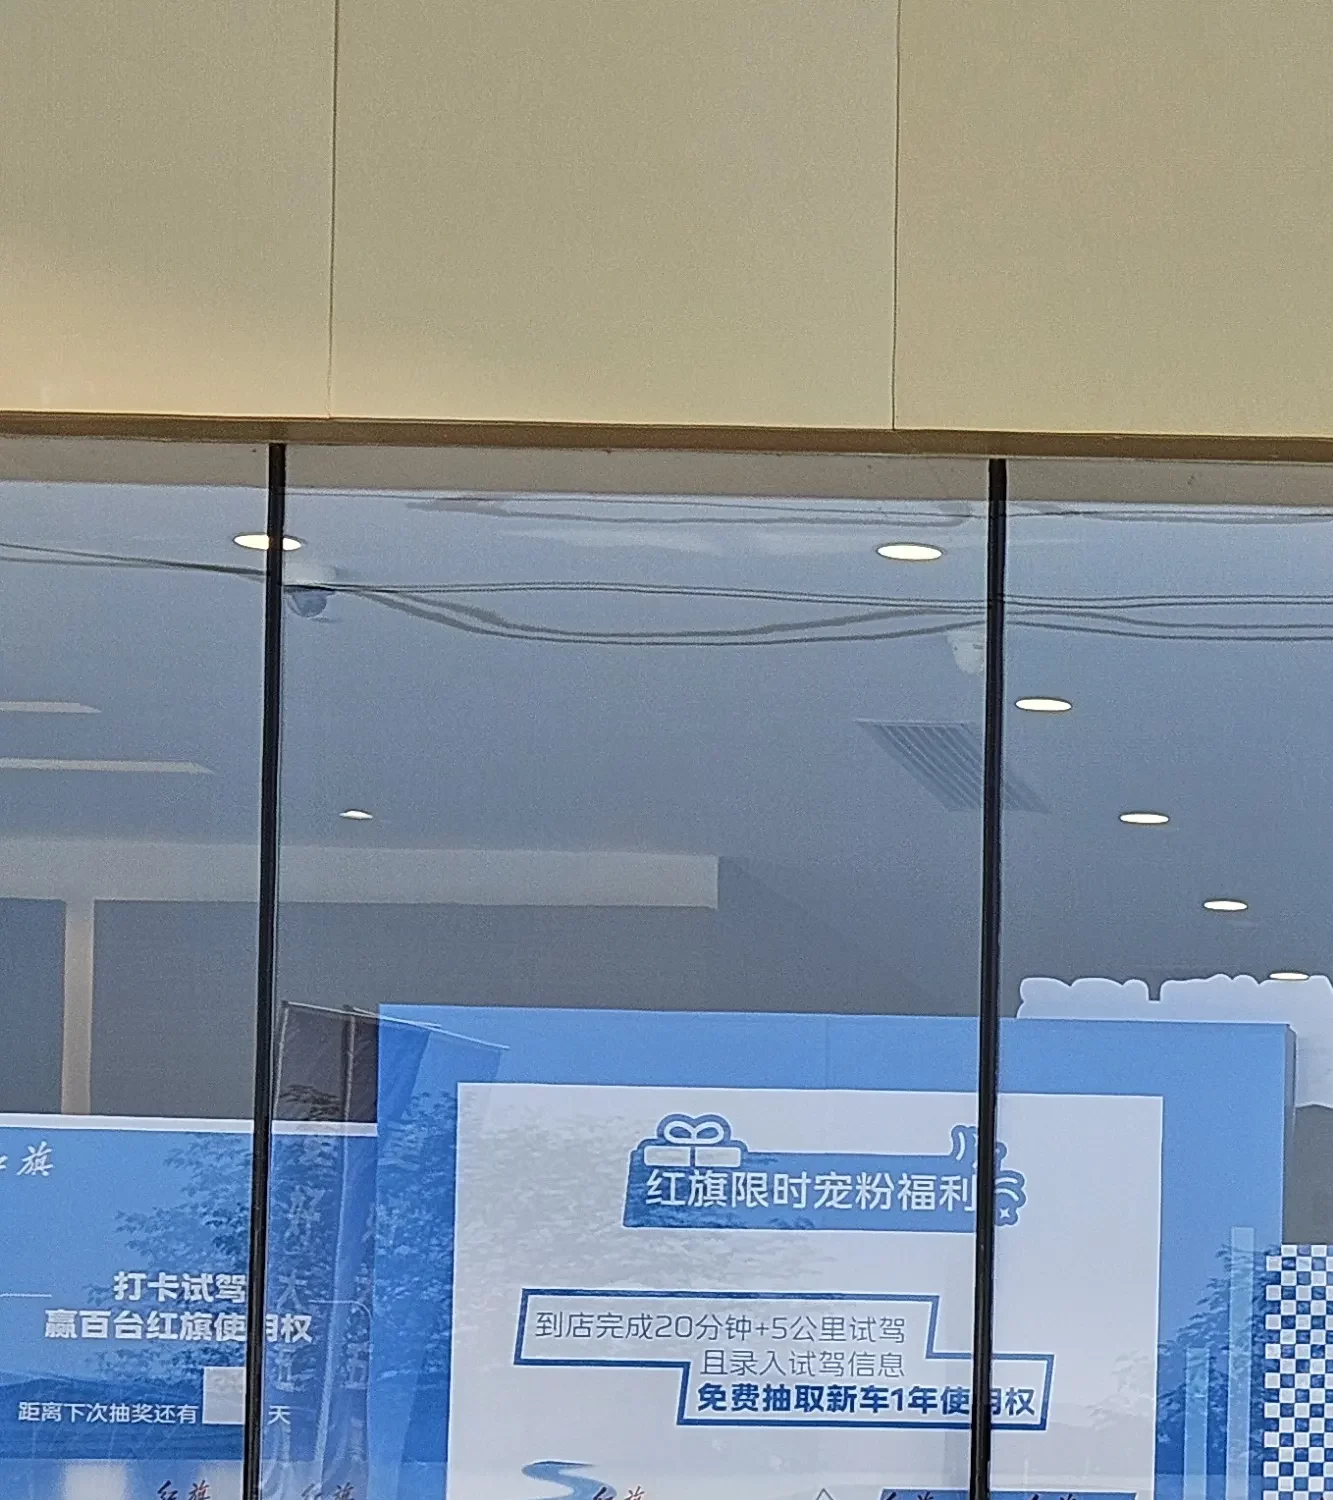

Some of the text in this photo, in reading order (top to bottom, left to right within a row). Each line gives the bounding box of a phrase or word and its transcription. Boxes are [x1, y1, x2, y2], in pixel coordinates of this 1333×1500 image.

[0, 1140, 54, 1177] 旗
[644, 1168, 977, 1213] 红旗限时宠粉福利
[113, 1271, 248, 1303] 打卡试驾
[534, 1312, 906, 1344] 到店完成20分钟+5公里试驾
[701, 1349, 906, 1378] 且录入试驾信息
[18, 1402, 292, 1425] 距离下次抽奖还有 天
